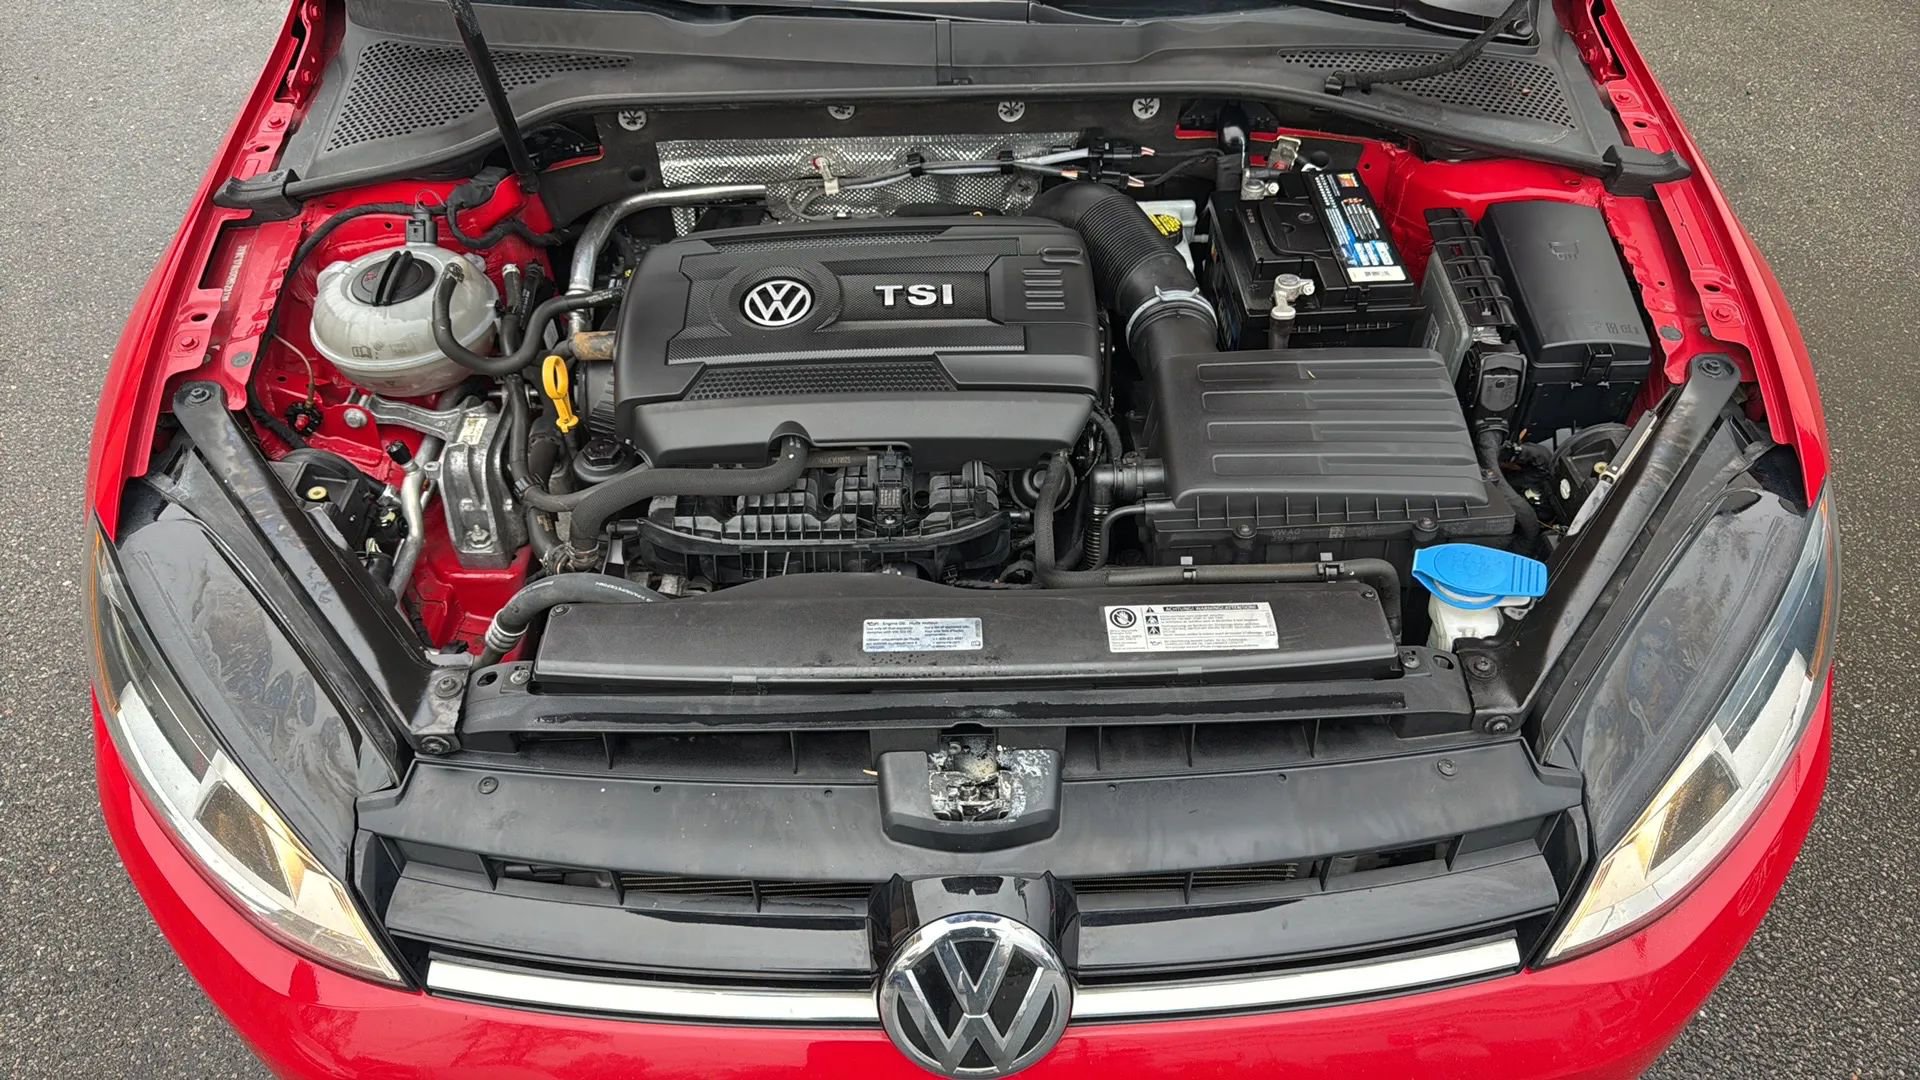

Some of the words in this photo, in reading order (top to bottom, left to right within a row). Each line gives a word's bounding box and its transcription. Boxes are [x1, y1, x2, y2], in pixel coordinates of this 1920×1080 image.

[746, 281, 810, 325] VW
[875, 284, 953, 306] TSI
[885, 922, 1067, 1077] VW
